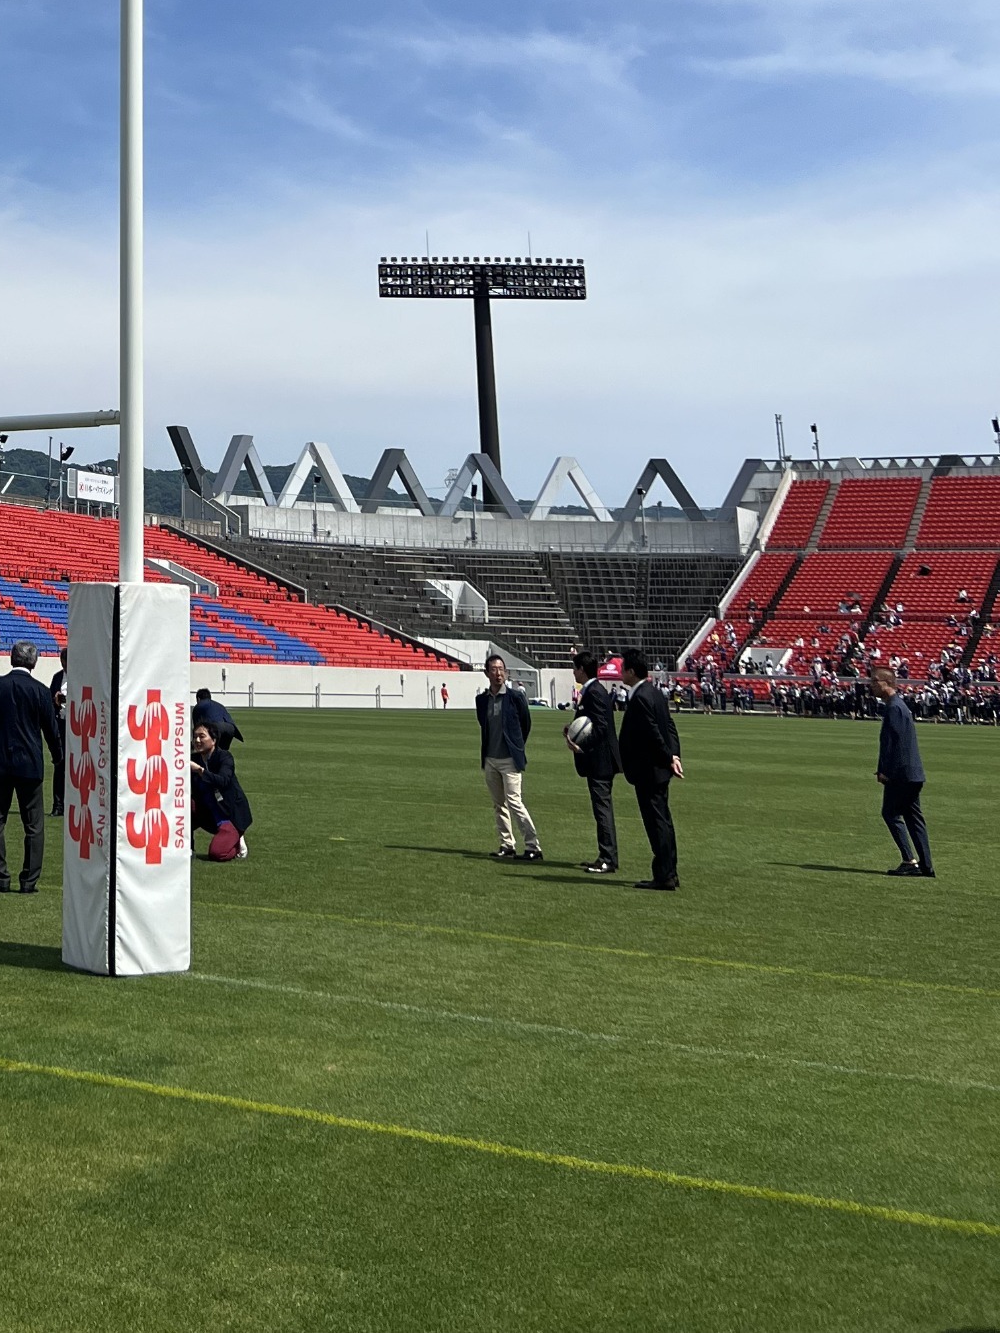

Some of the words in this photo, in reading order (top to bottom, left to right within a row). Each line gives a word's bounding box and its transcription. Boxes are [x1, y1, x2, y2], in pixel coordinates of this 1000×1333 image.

[97, 701, 107, 769] GYPSUM
[174, 703, 185, 770] GYPSUM
[98, 775, 106, 807] ESU
[174, 777, 185, 808] ESU
[96, 814, 106, 847] SAN
[174, 816, 185, 848] SAN
